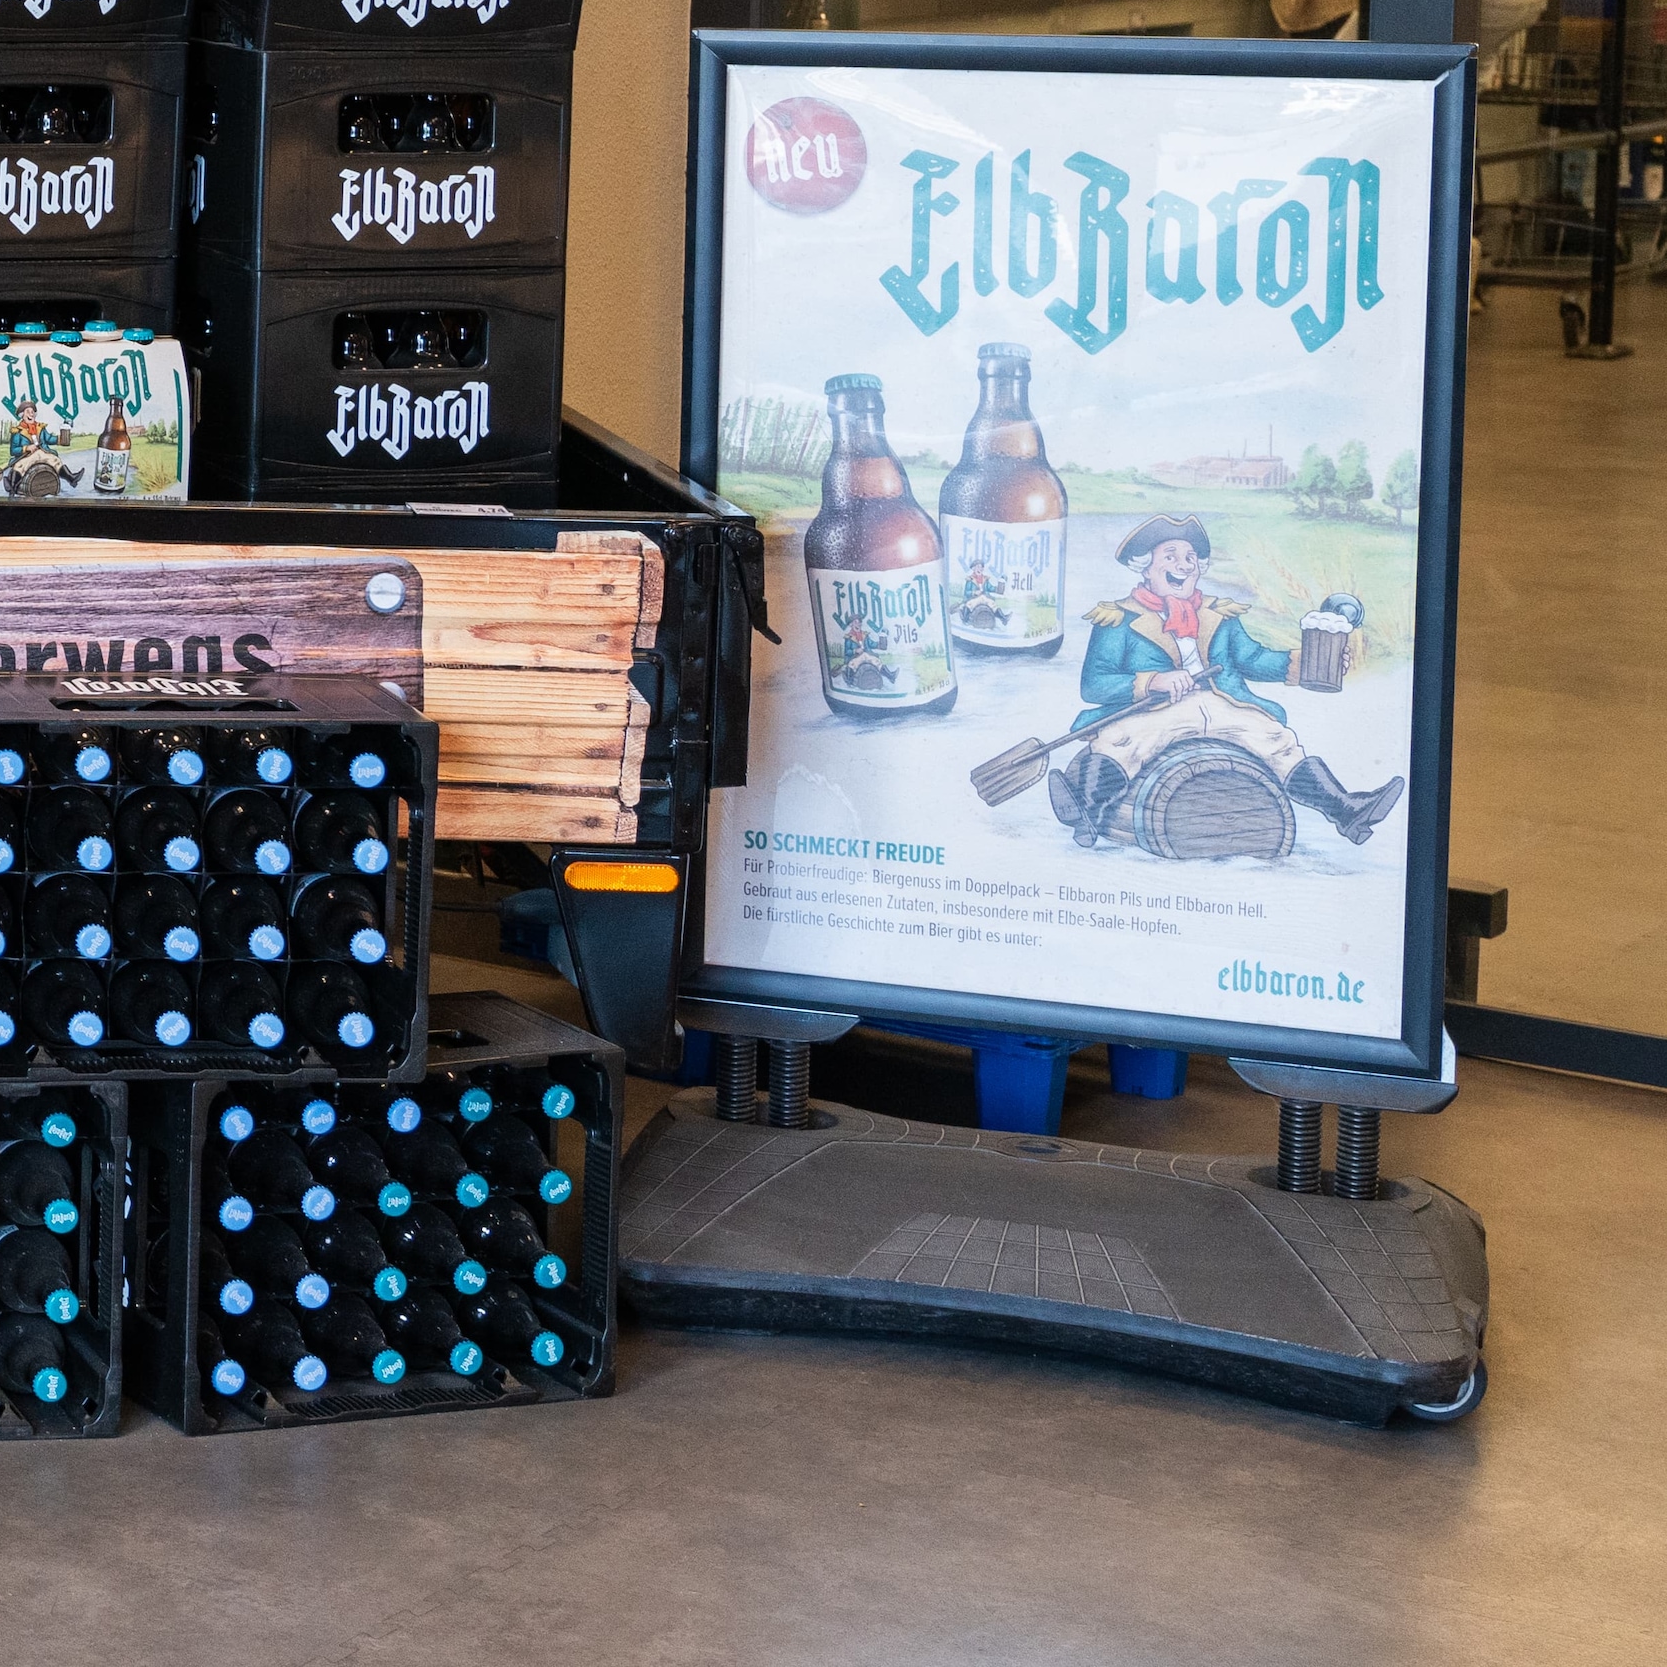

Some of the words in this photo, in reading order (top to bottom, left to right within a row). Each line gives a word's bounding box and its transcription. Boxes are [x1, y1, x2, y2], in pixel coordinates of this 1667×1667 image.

[766, 121, 842, 187] neu
[330, 165, 497, 245] ElbBaron
[879, 148, 1385, 354] ElbBaron
[1, 349, 152, 421] ElbBaron
[326, 381, 490, 461] ElbBaron
[1011, 571, 1033, 591] Hell
[893, 623, 918, 645] Pils
[744, 830, 767, 850] SO
[772, 832, 871, 859] SCHMECKT
[875, 841, 946, 866] FREUDE
[744, 857, 763, 874] Für
[768, 859, 868, 883] Probierfreudige:
[872, 869, 942, 890] Biergenuss
[946, 875, 961, 891] im
[965, 877, 1040, 899] Doppelpack
[1058, 885, 1116, 906] Elbbaron
[1120, 890, 1142, 908] Pils
[1146, 895, 1171, 910] und
[1175, 896, 1233, 916] Elbbaron
[1238, 902, 1267, 919] Hell.
[744, 881, 792, 901] Gebraut
[796, 889, 817, 902] aus
[821, 889, 883, 909] erlesenen
[886, 894, 938, 915] Zutaten,
[943, 899, 1028, 921] insbesondere
[1033, 909, 1054, 924] mit
[1058, 909, 1182, 936] Elbe-Saale-Hopfen.
[743, 905, 763, 921] Die
[767, 906, 824, 927] fürstliche
[827, 912, 895, 934] Geschichte
[898, 921, 924, 936] zum
[929, 922, 954, 938] Bier
[957, 925, 982, 943] gibt
[985, 930, 1001, 943] es
[1005, 931, 1042, 947] unter:
[1217, 958, 1365, 1004] elbbaron.de
